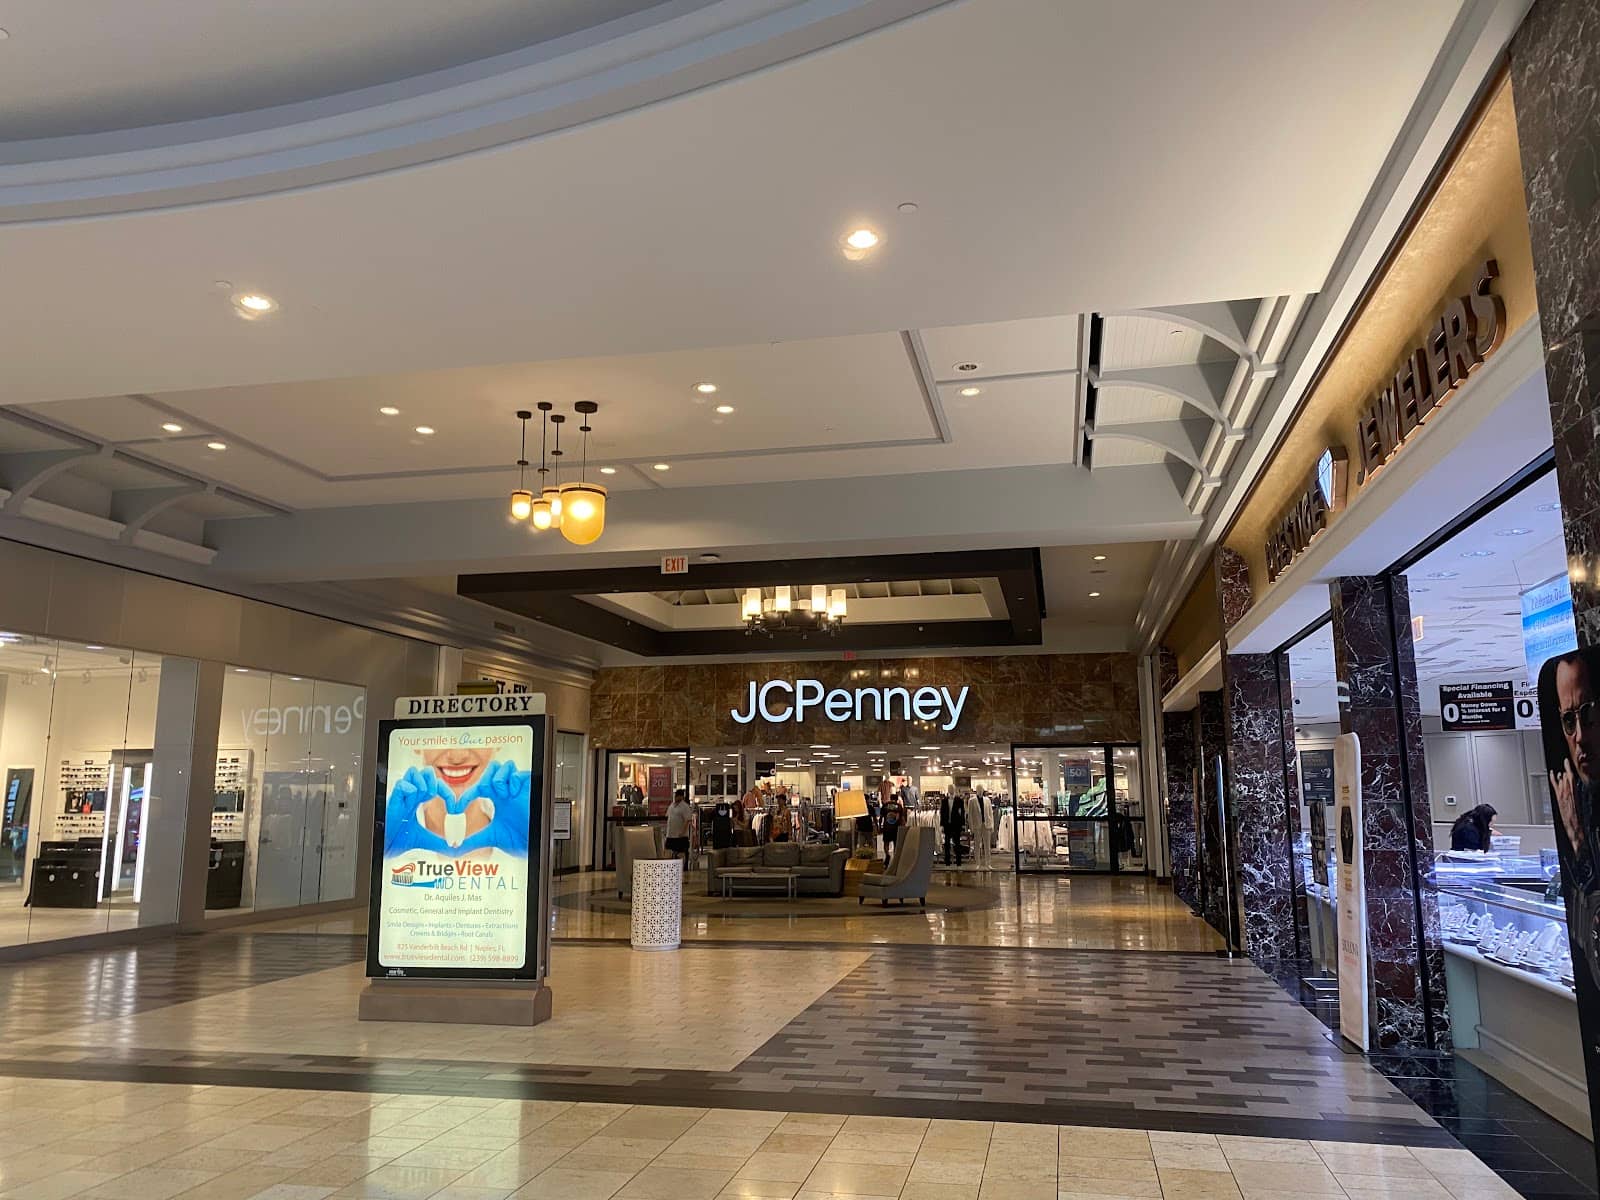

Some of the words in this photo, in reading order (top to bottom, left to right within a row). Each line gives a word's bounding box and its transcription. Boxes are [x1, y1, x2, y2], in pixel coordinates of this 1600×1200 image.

[1356, 259, 1506, 488] JEWELERS
[665, 558, 686, 572] EXIT
[1442, 684, 1470, 692] Special
[1471, 682, 1509, 690] Financing
[1457, 691, 1493, 699] Available
[408, 696, 533, 715] DIRECTORY
[730, 679, 969, 731] JCPenney
[1516, 699, 1534, 718] 0
[1443, 703, 1460, 723] 0
[398, 736, 420, 746] Your
[422, 735, 448, 746] smile
[450, 735, 457, 745] is
[485, 734, 523, 745] passion
[417, 860, 499, 876] TrueView
[444, 876, 519, 890] DENTAL
[424, 893, 434, 902] Dr.
[435, 893, 460, 903] Aquiles
[468, 893, 482, 902] Mas
[419, 907, 443, 915] General
[446, 907, 457, 915] and
[484, 907, 514, 917] Dentistry
